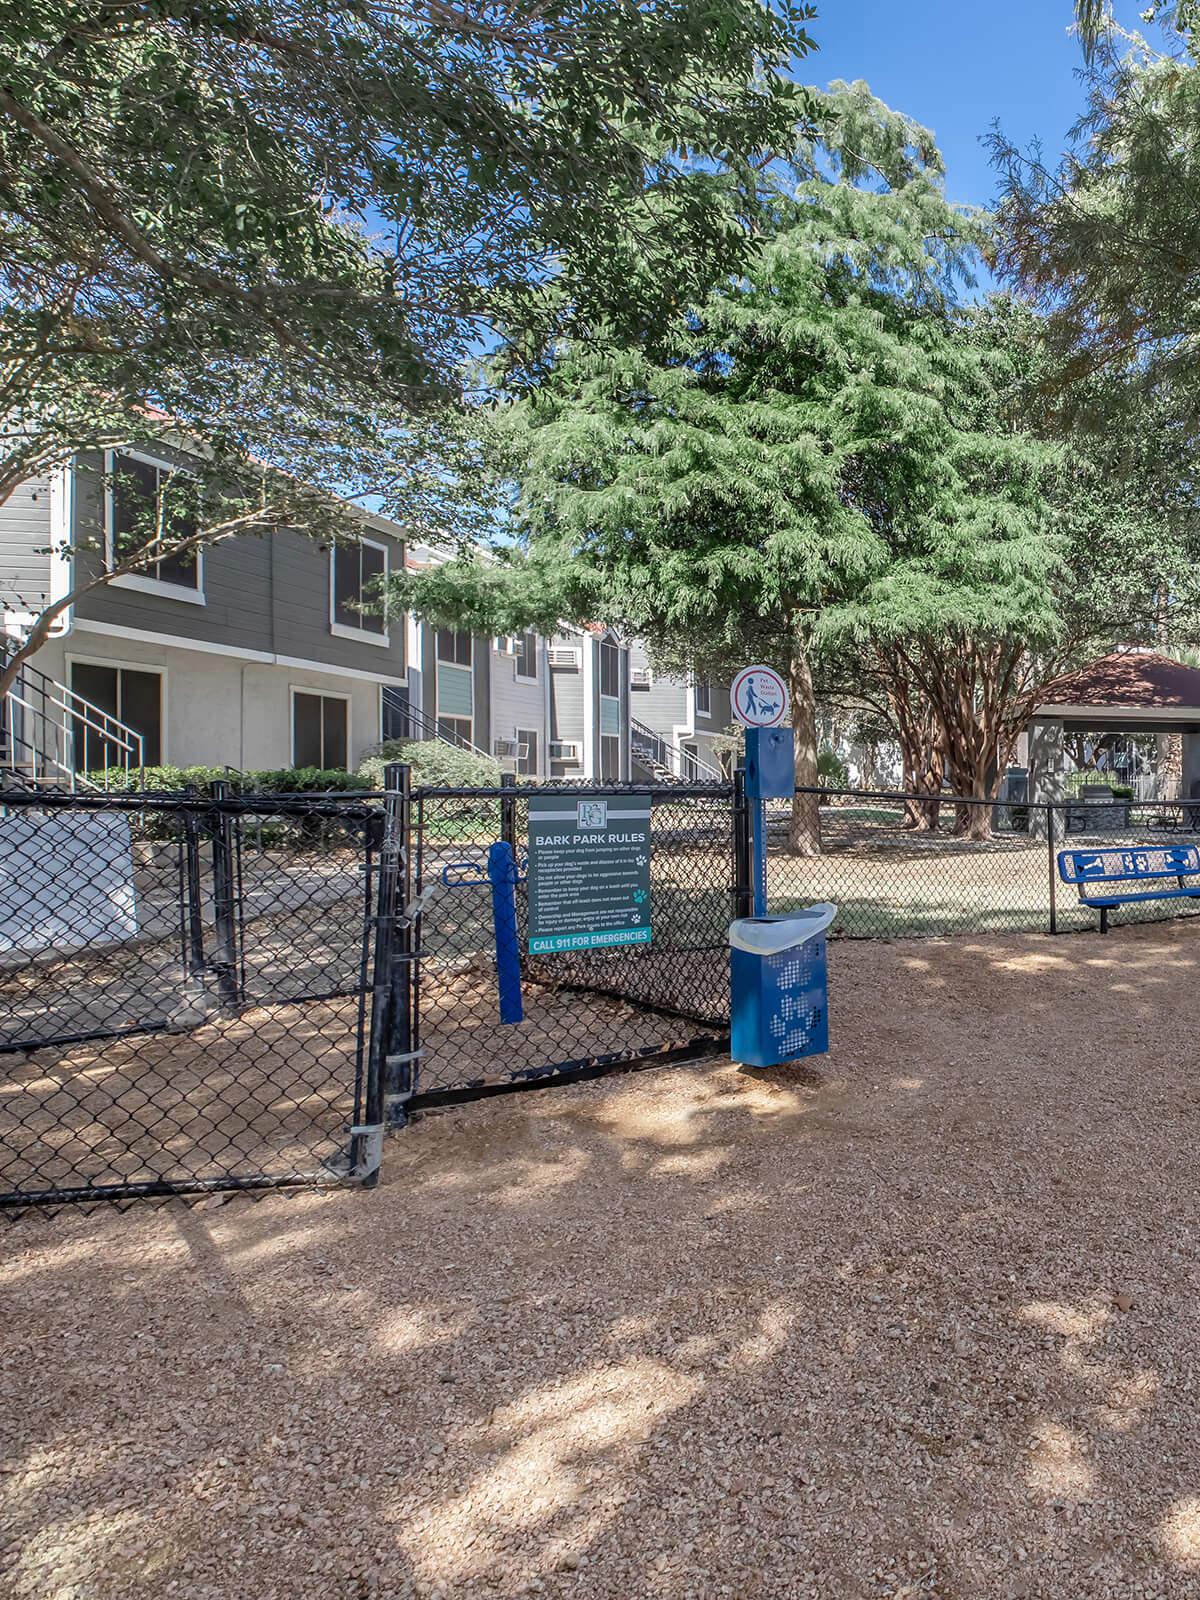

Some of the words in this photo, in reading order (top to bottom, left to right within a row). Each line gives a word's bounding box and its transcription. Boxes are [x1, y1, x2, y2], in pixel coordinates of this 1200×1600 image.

[536, 834, 570, 846] BARK
[573, 833, 606, 845] PARK
[608, 833, 646, 843] RULES
[533, 940, 555, 951] CALL
[557, 938, 571, 948] 911
[572, 936, 589, 946] FOR
[591, 930, 648, 945] EMERGENCIES
